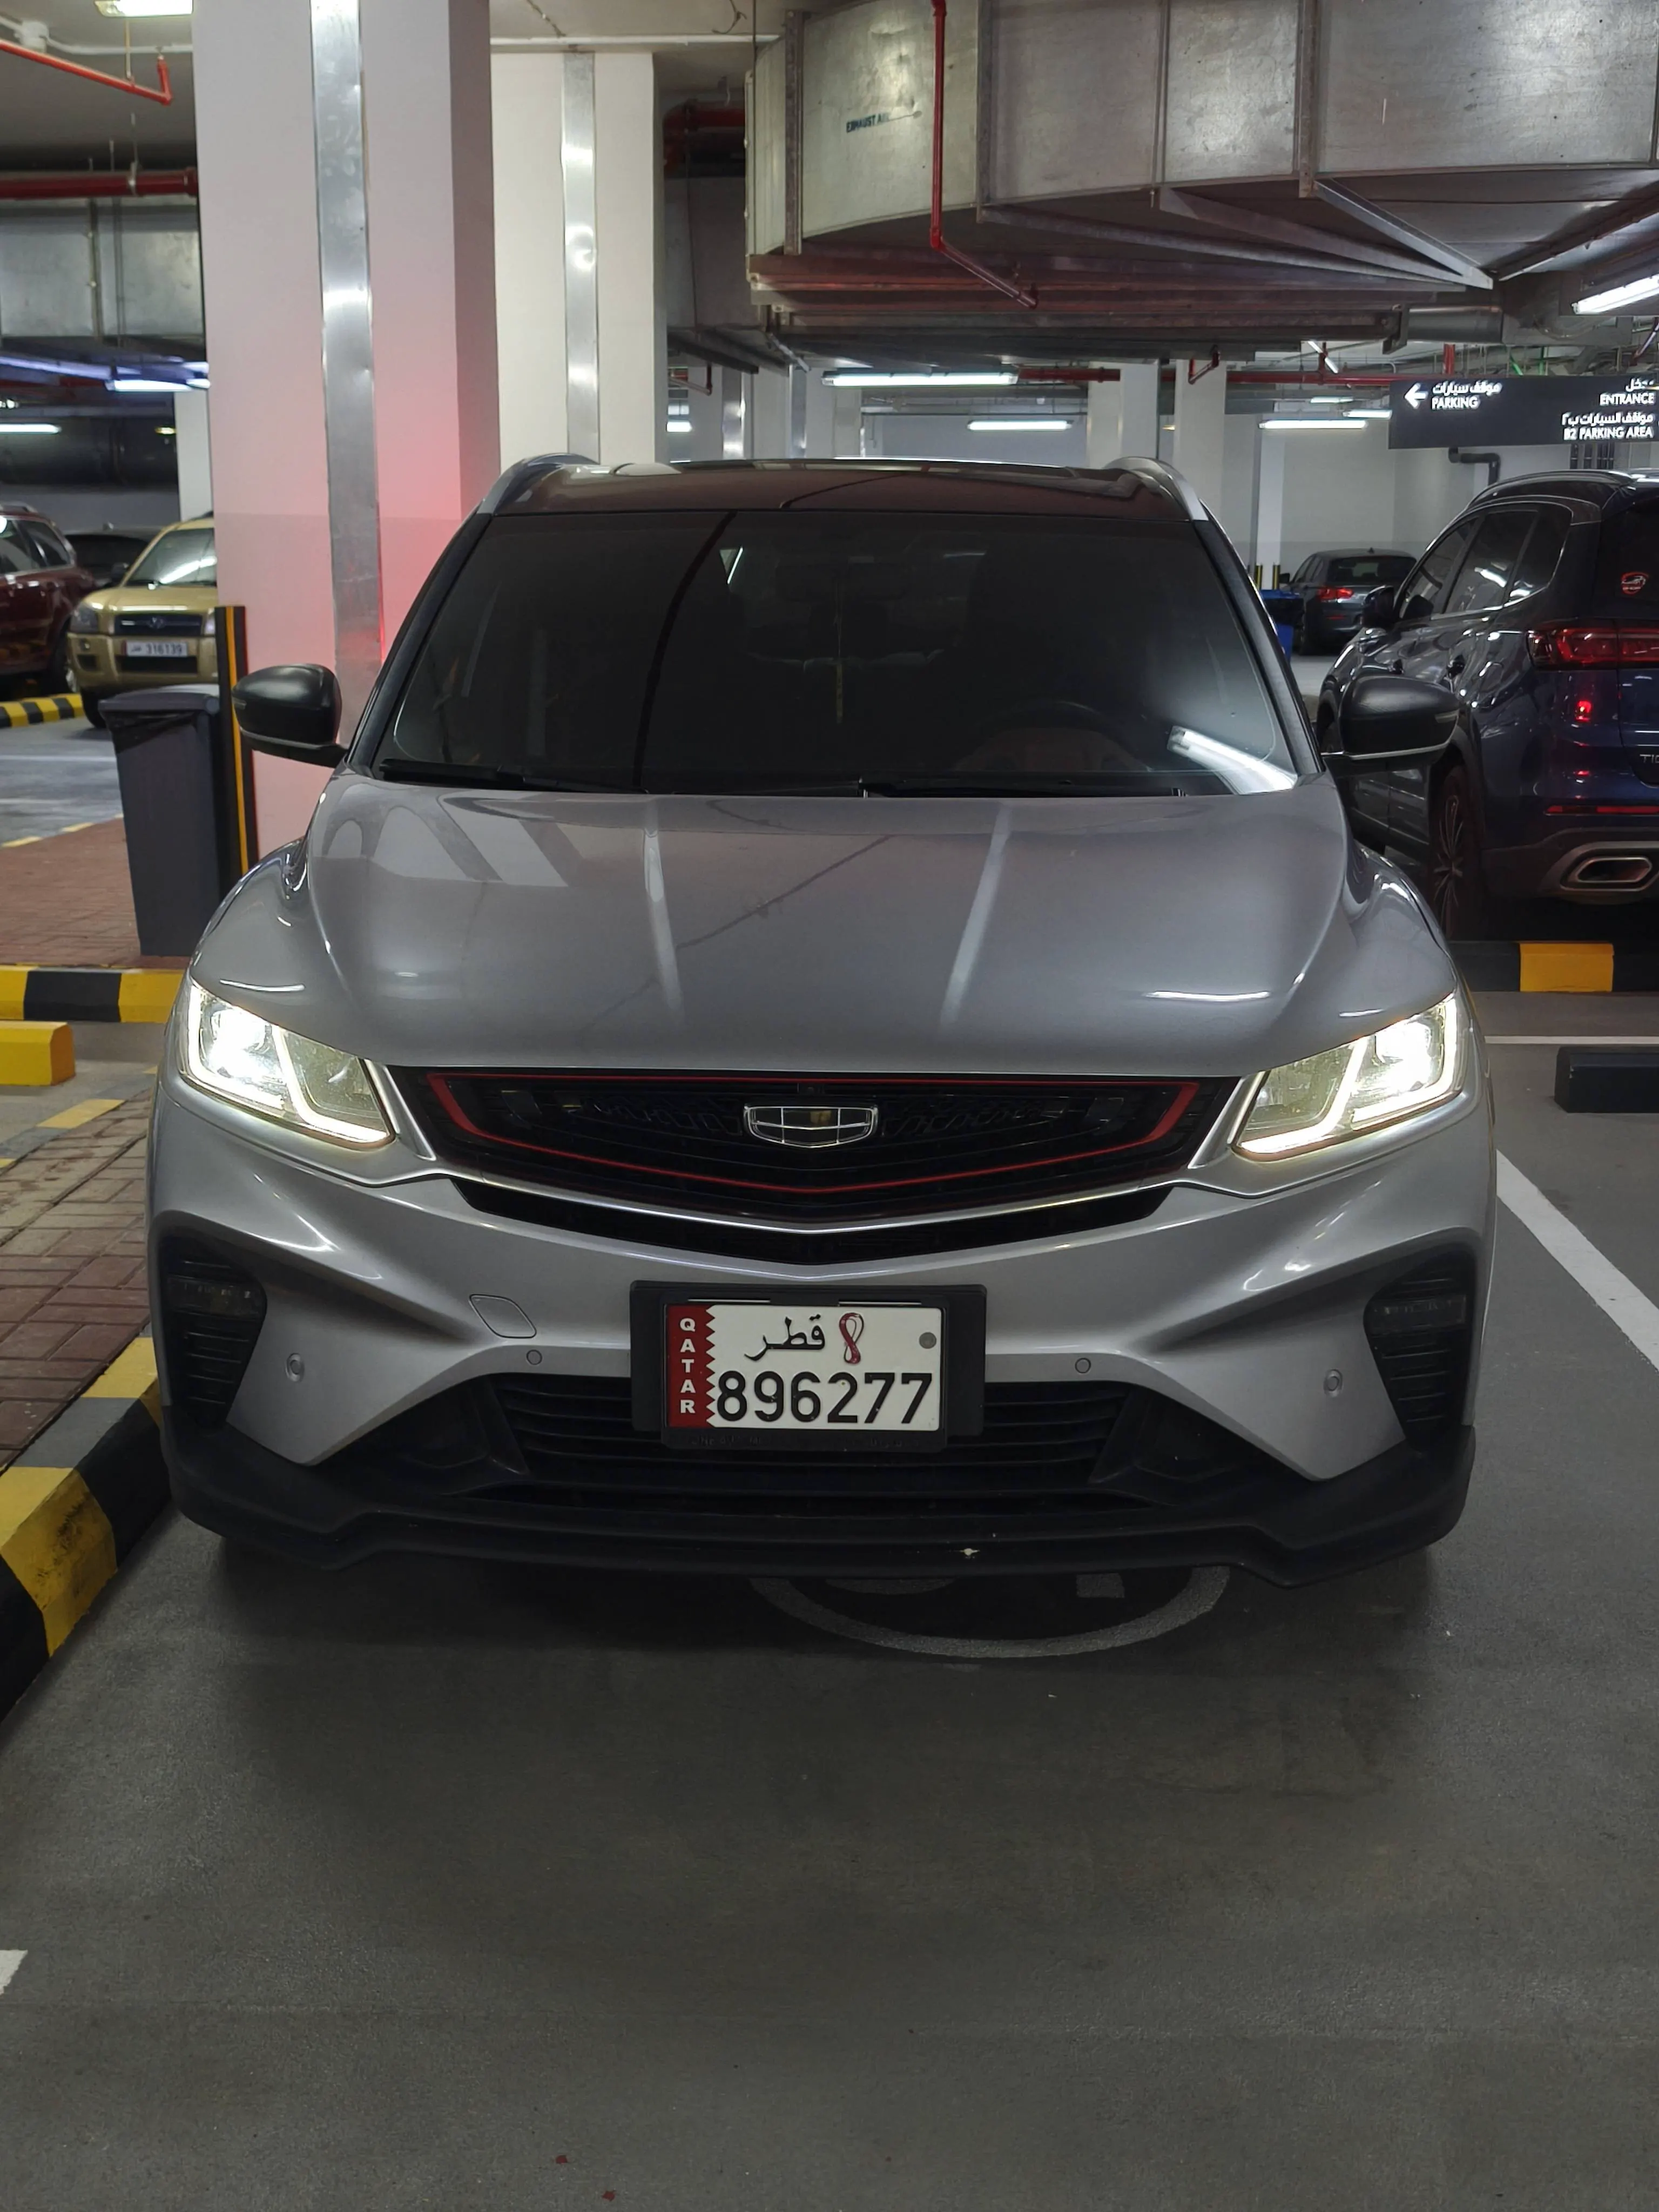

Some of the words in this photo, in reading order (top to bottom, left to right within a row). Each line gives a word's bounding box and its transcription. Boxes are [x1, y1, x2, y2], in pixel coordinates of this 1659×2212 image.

[1431, 395, 1480, 410] PARKING
[1600, 392, 1655, 406] ENTRANCE
[1563, 427, 1577, 440] B2
[1579, 426, 1625, 440] PARKING
[1626, 426, 1654, 439] AREA
[744, 1313, 826, 1362] قطر
[679, 1318, 696, 1414] QATAR
[716, 1370, 933, 1424] 896277
